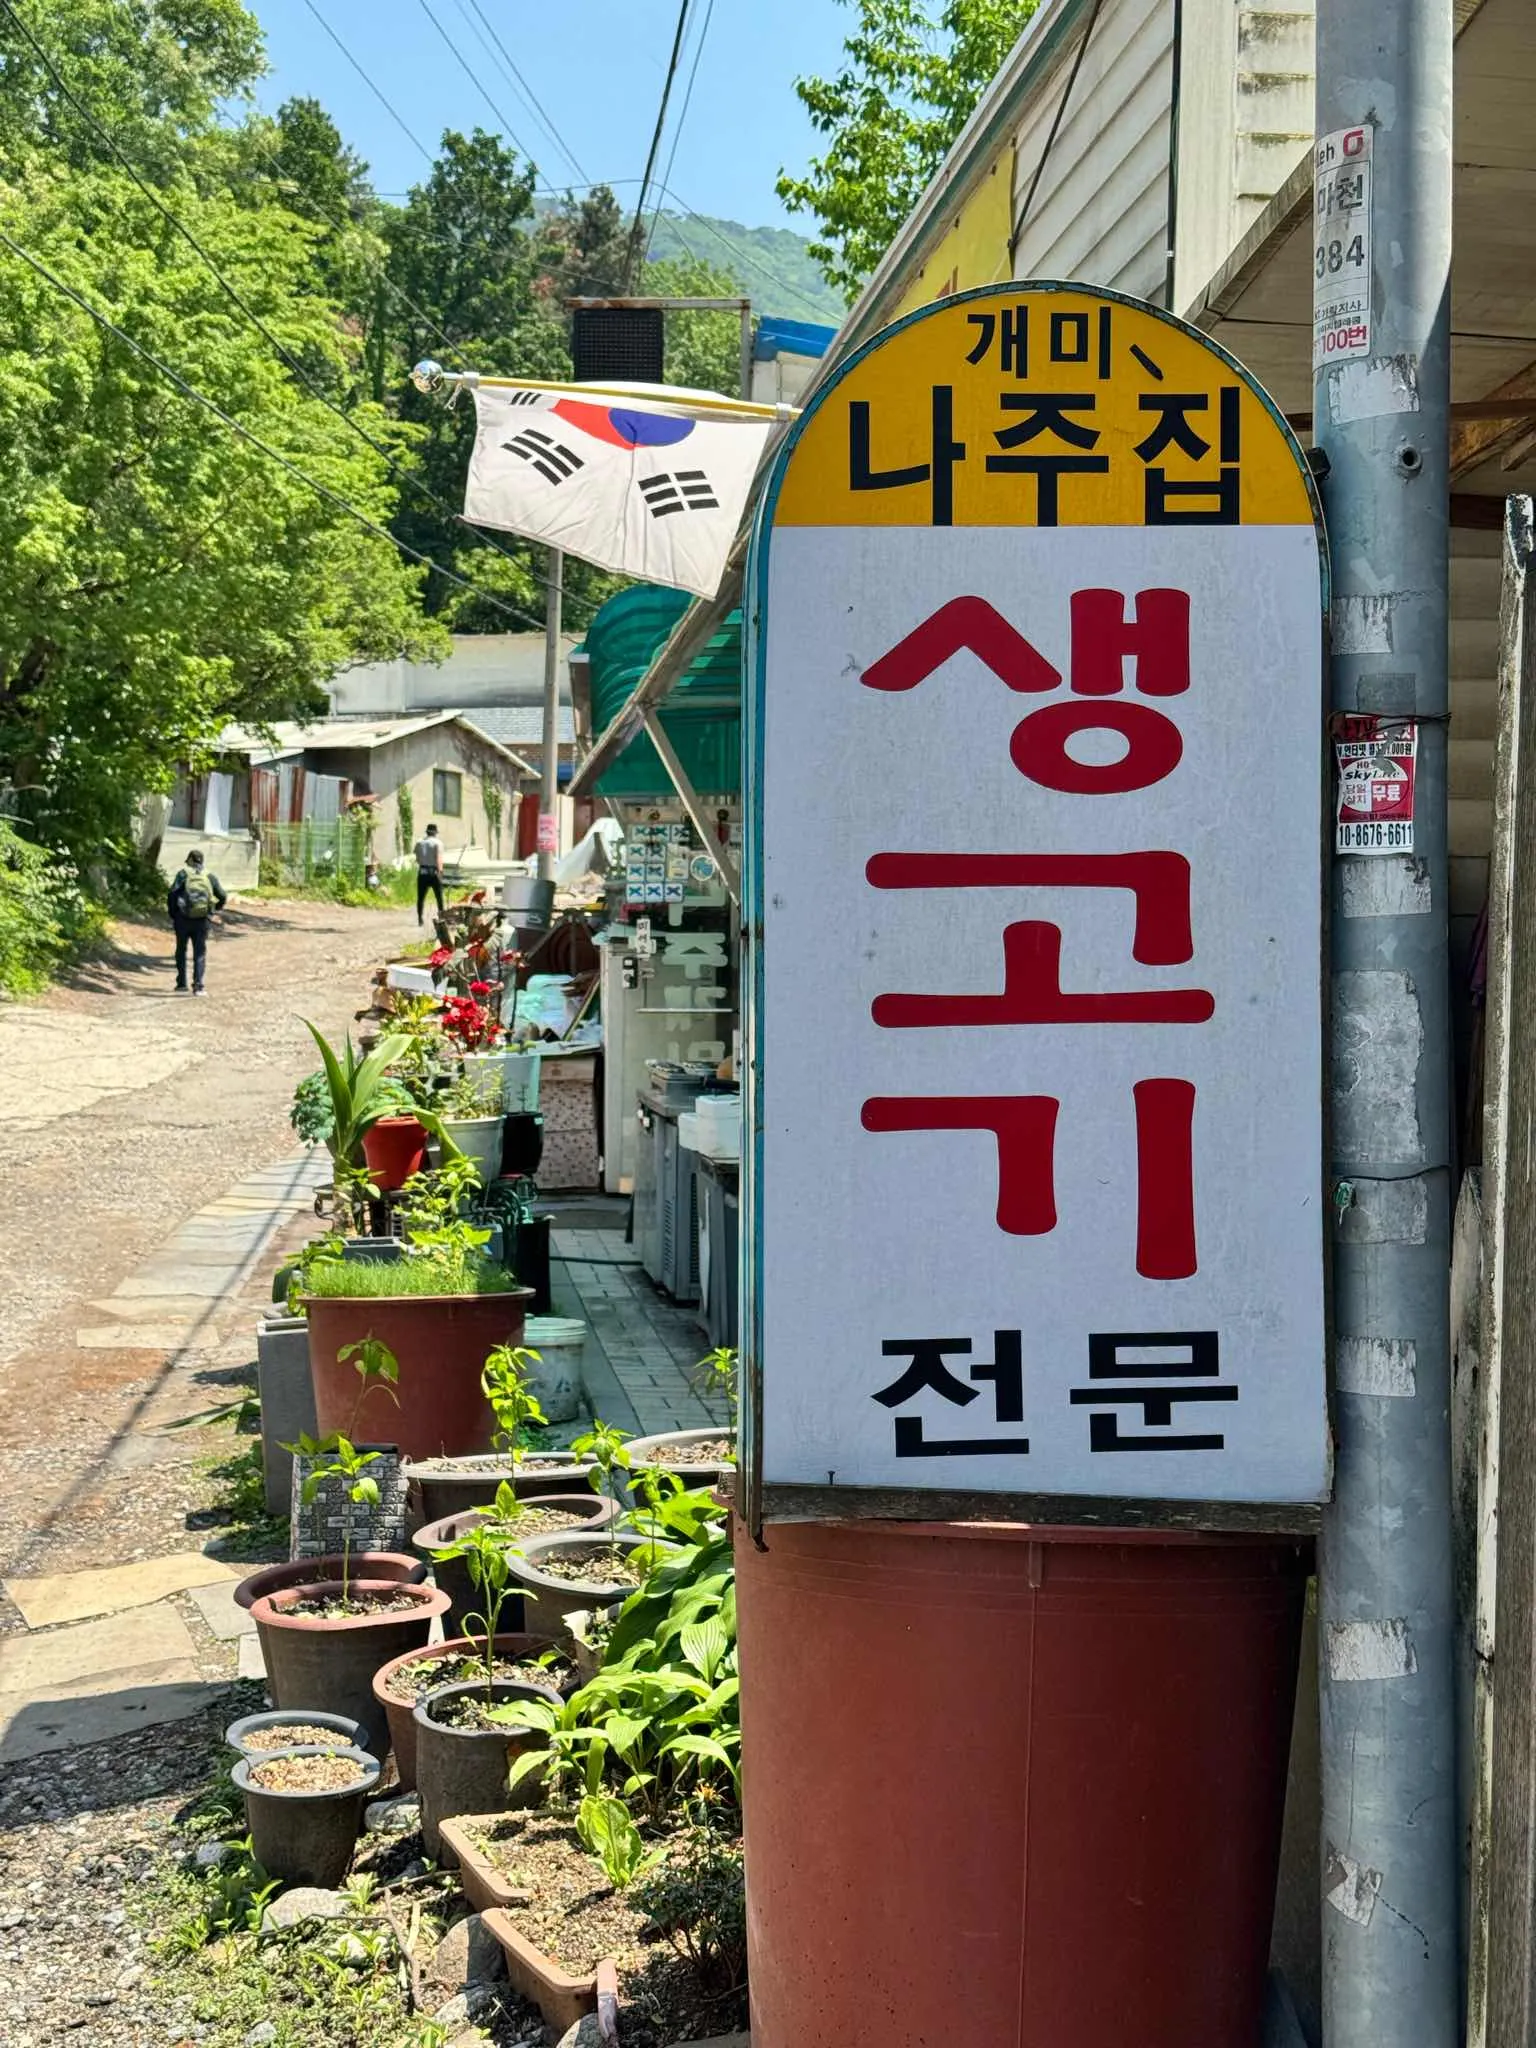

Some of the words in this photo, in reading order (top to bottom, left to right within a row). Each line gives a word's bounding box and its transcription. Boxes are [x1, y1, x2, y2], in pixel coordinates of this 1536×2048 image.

[1315, 234, 1365, 280] 384
[849, 385, 1241, 528] 나주집
[1372, 784, 1401, 802] 무료
[870, 1329, 1239, 1458] 전문
